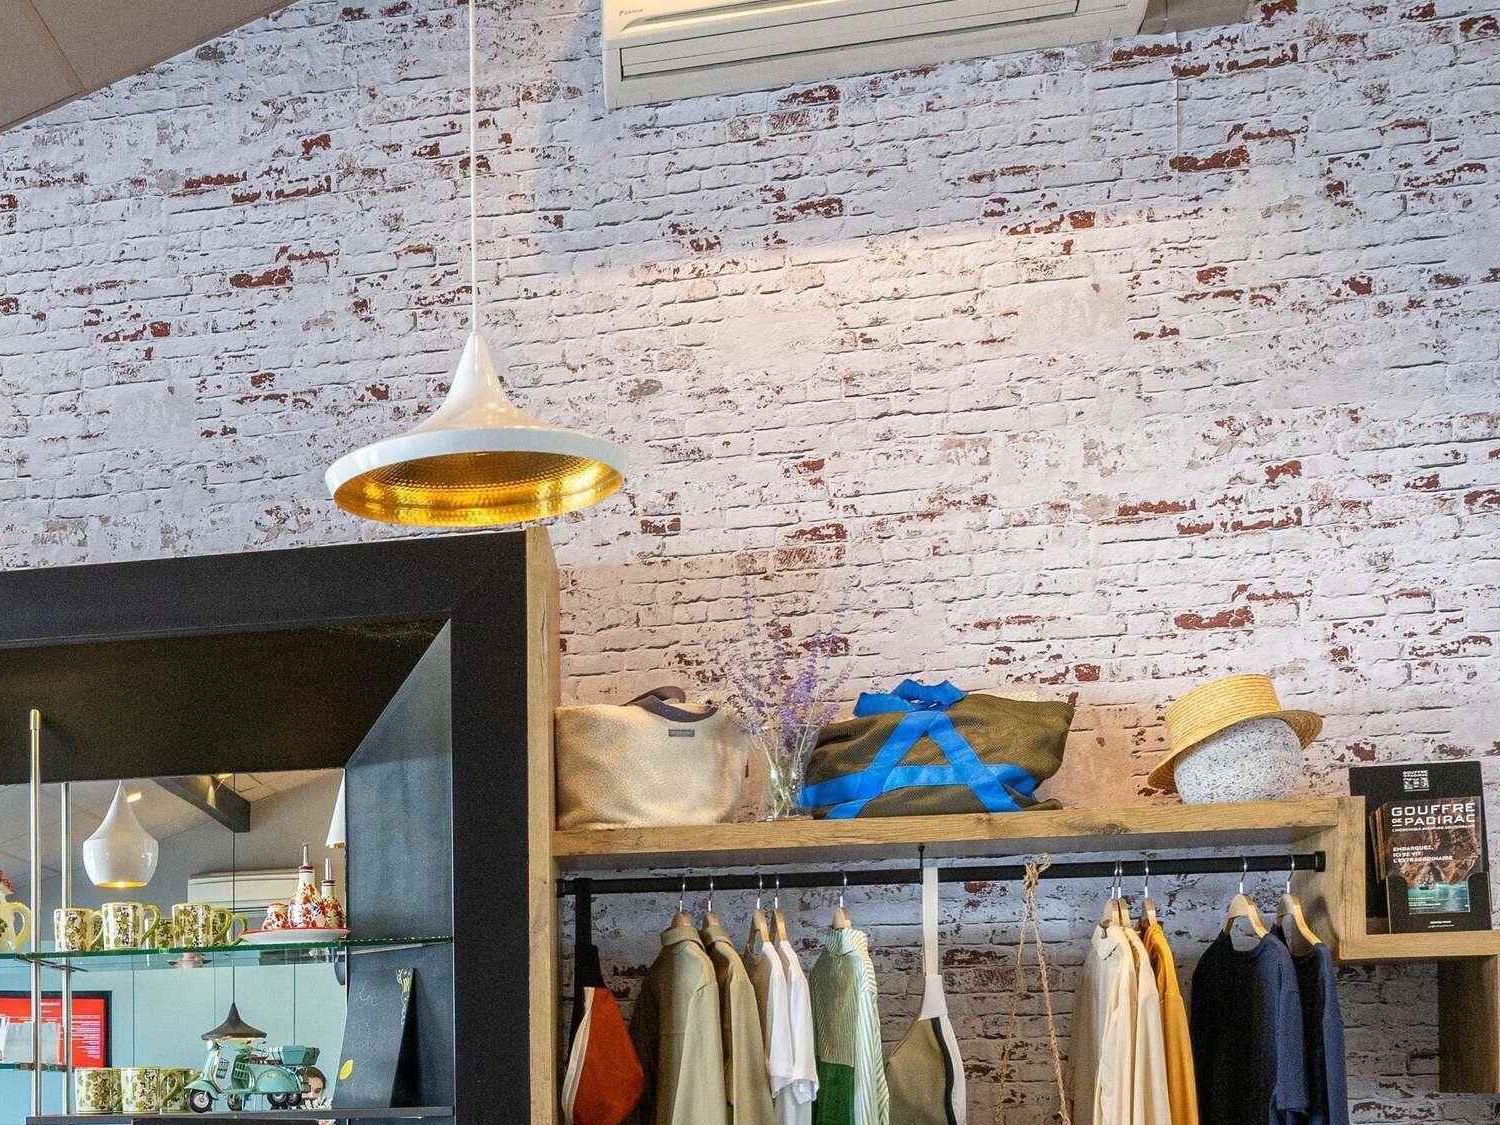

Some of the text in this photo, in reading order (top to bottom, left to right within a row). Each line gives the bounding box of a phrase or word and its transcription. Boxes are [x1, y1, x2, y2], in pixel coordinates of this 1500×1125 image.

[1391, 803, 1475, 817] GOUFFRE
[1392, 814, 1475, 826] DE PADIRAC
